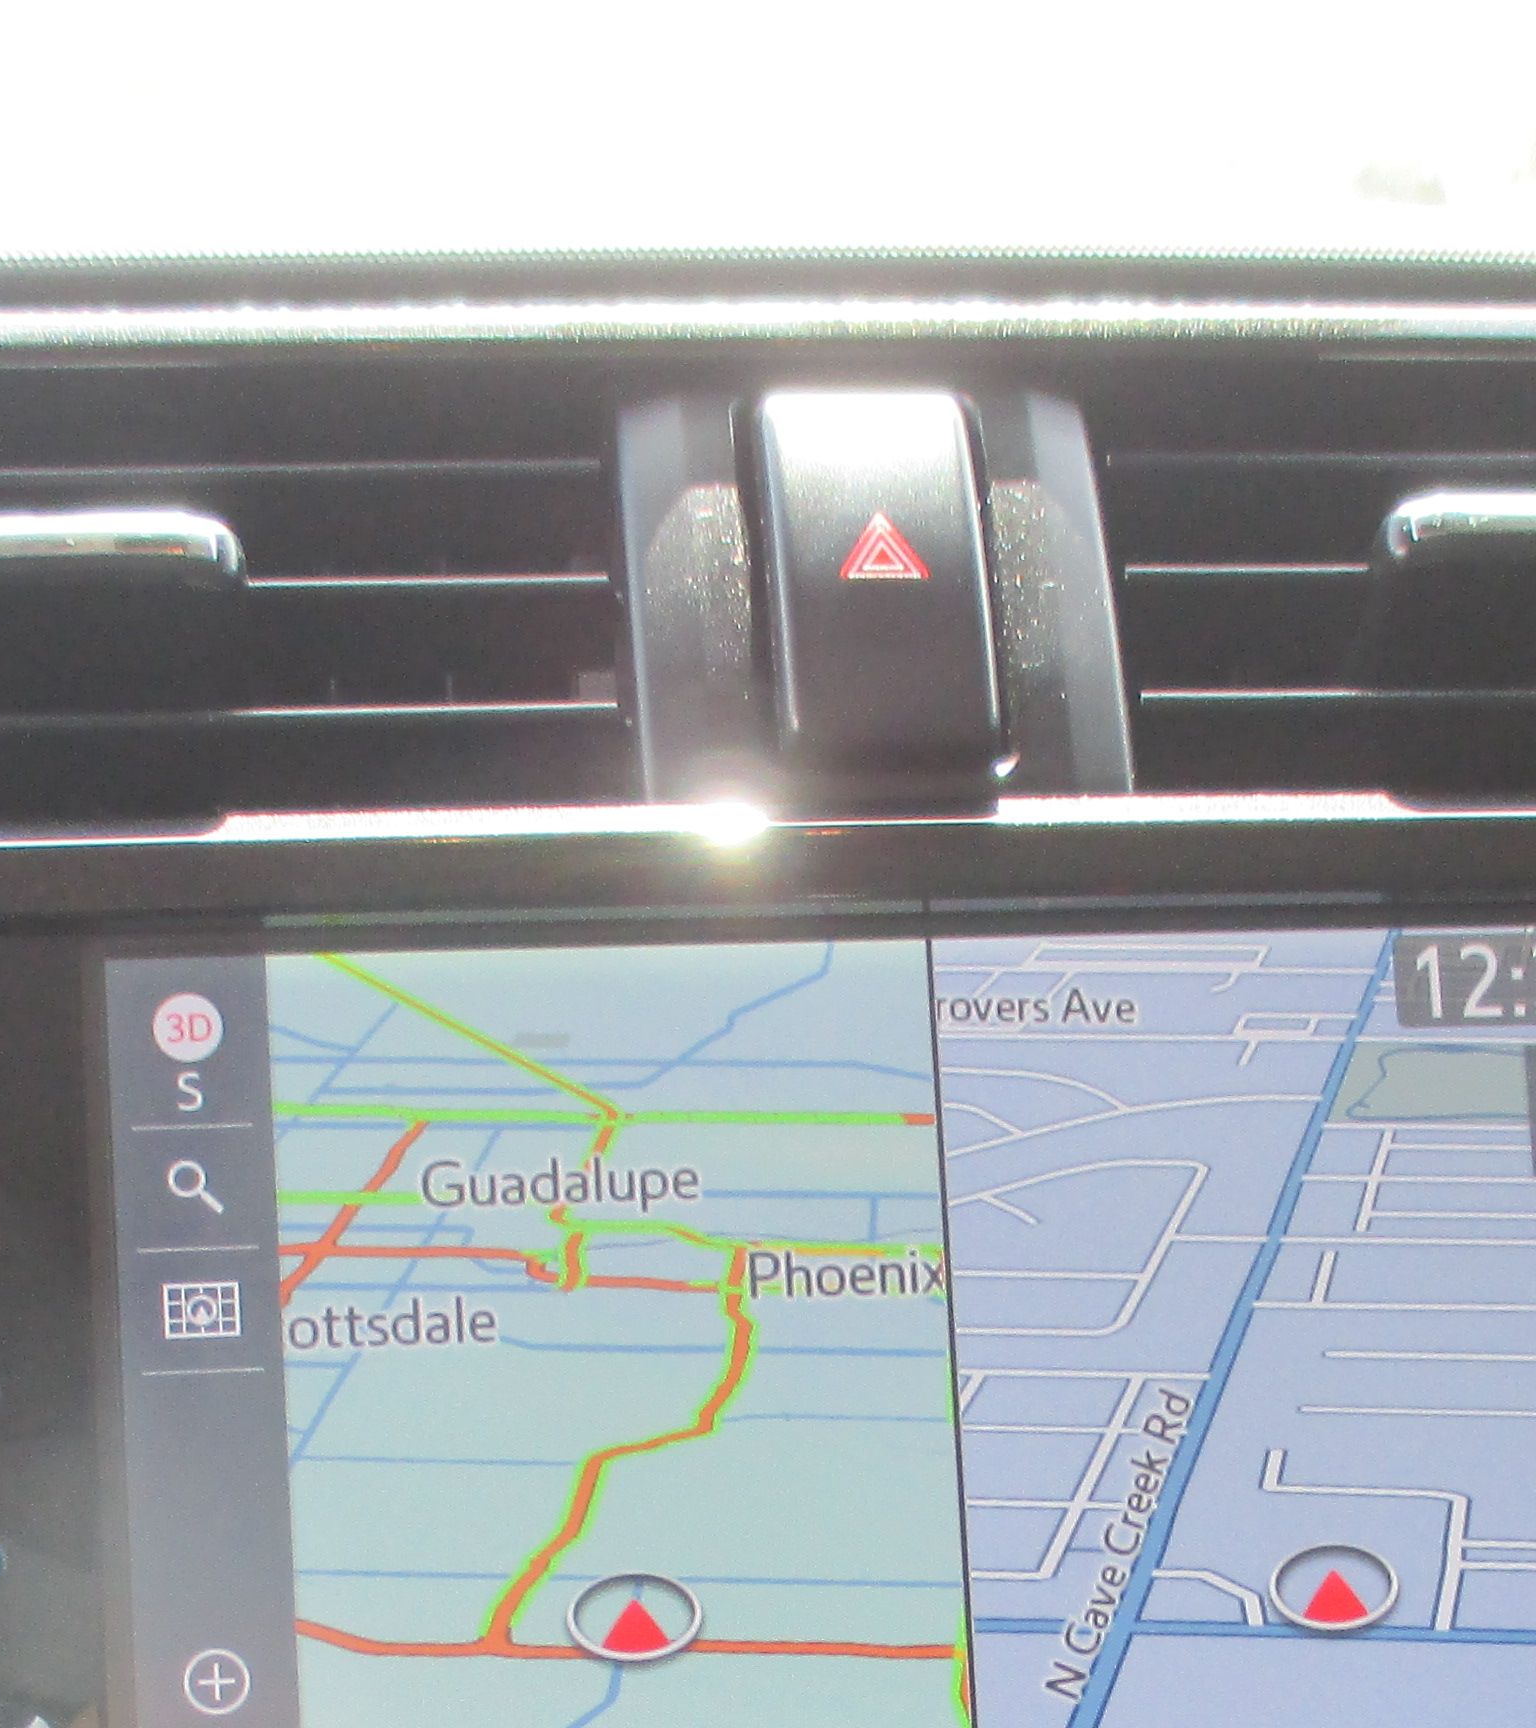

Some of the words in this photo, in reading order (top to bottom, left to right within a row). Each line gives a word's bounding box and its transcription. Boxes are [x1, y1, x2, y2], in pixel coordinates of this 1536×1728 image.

[164, 1010, 213, 1045] 3D
[1062, 987, 1136, 1023] Ave
[175, 1072, 204, 1112] S
[420, 1158, 700, 1213] Guadalupe
[747, 1249, 945, 1299] Phoenix
[1143, 1388, 1192, 1447] Rd
[1103, 1450, 1170, 1555] Creek
[1065, 1563, 1127, 1655] Cave
[1045, 1660, 1088, 1700] N
